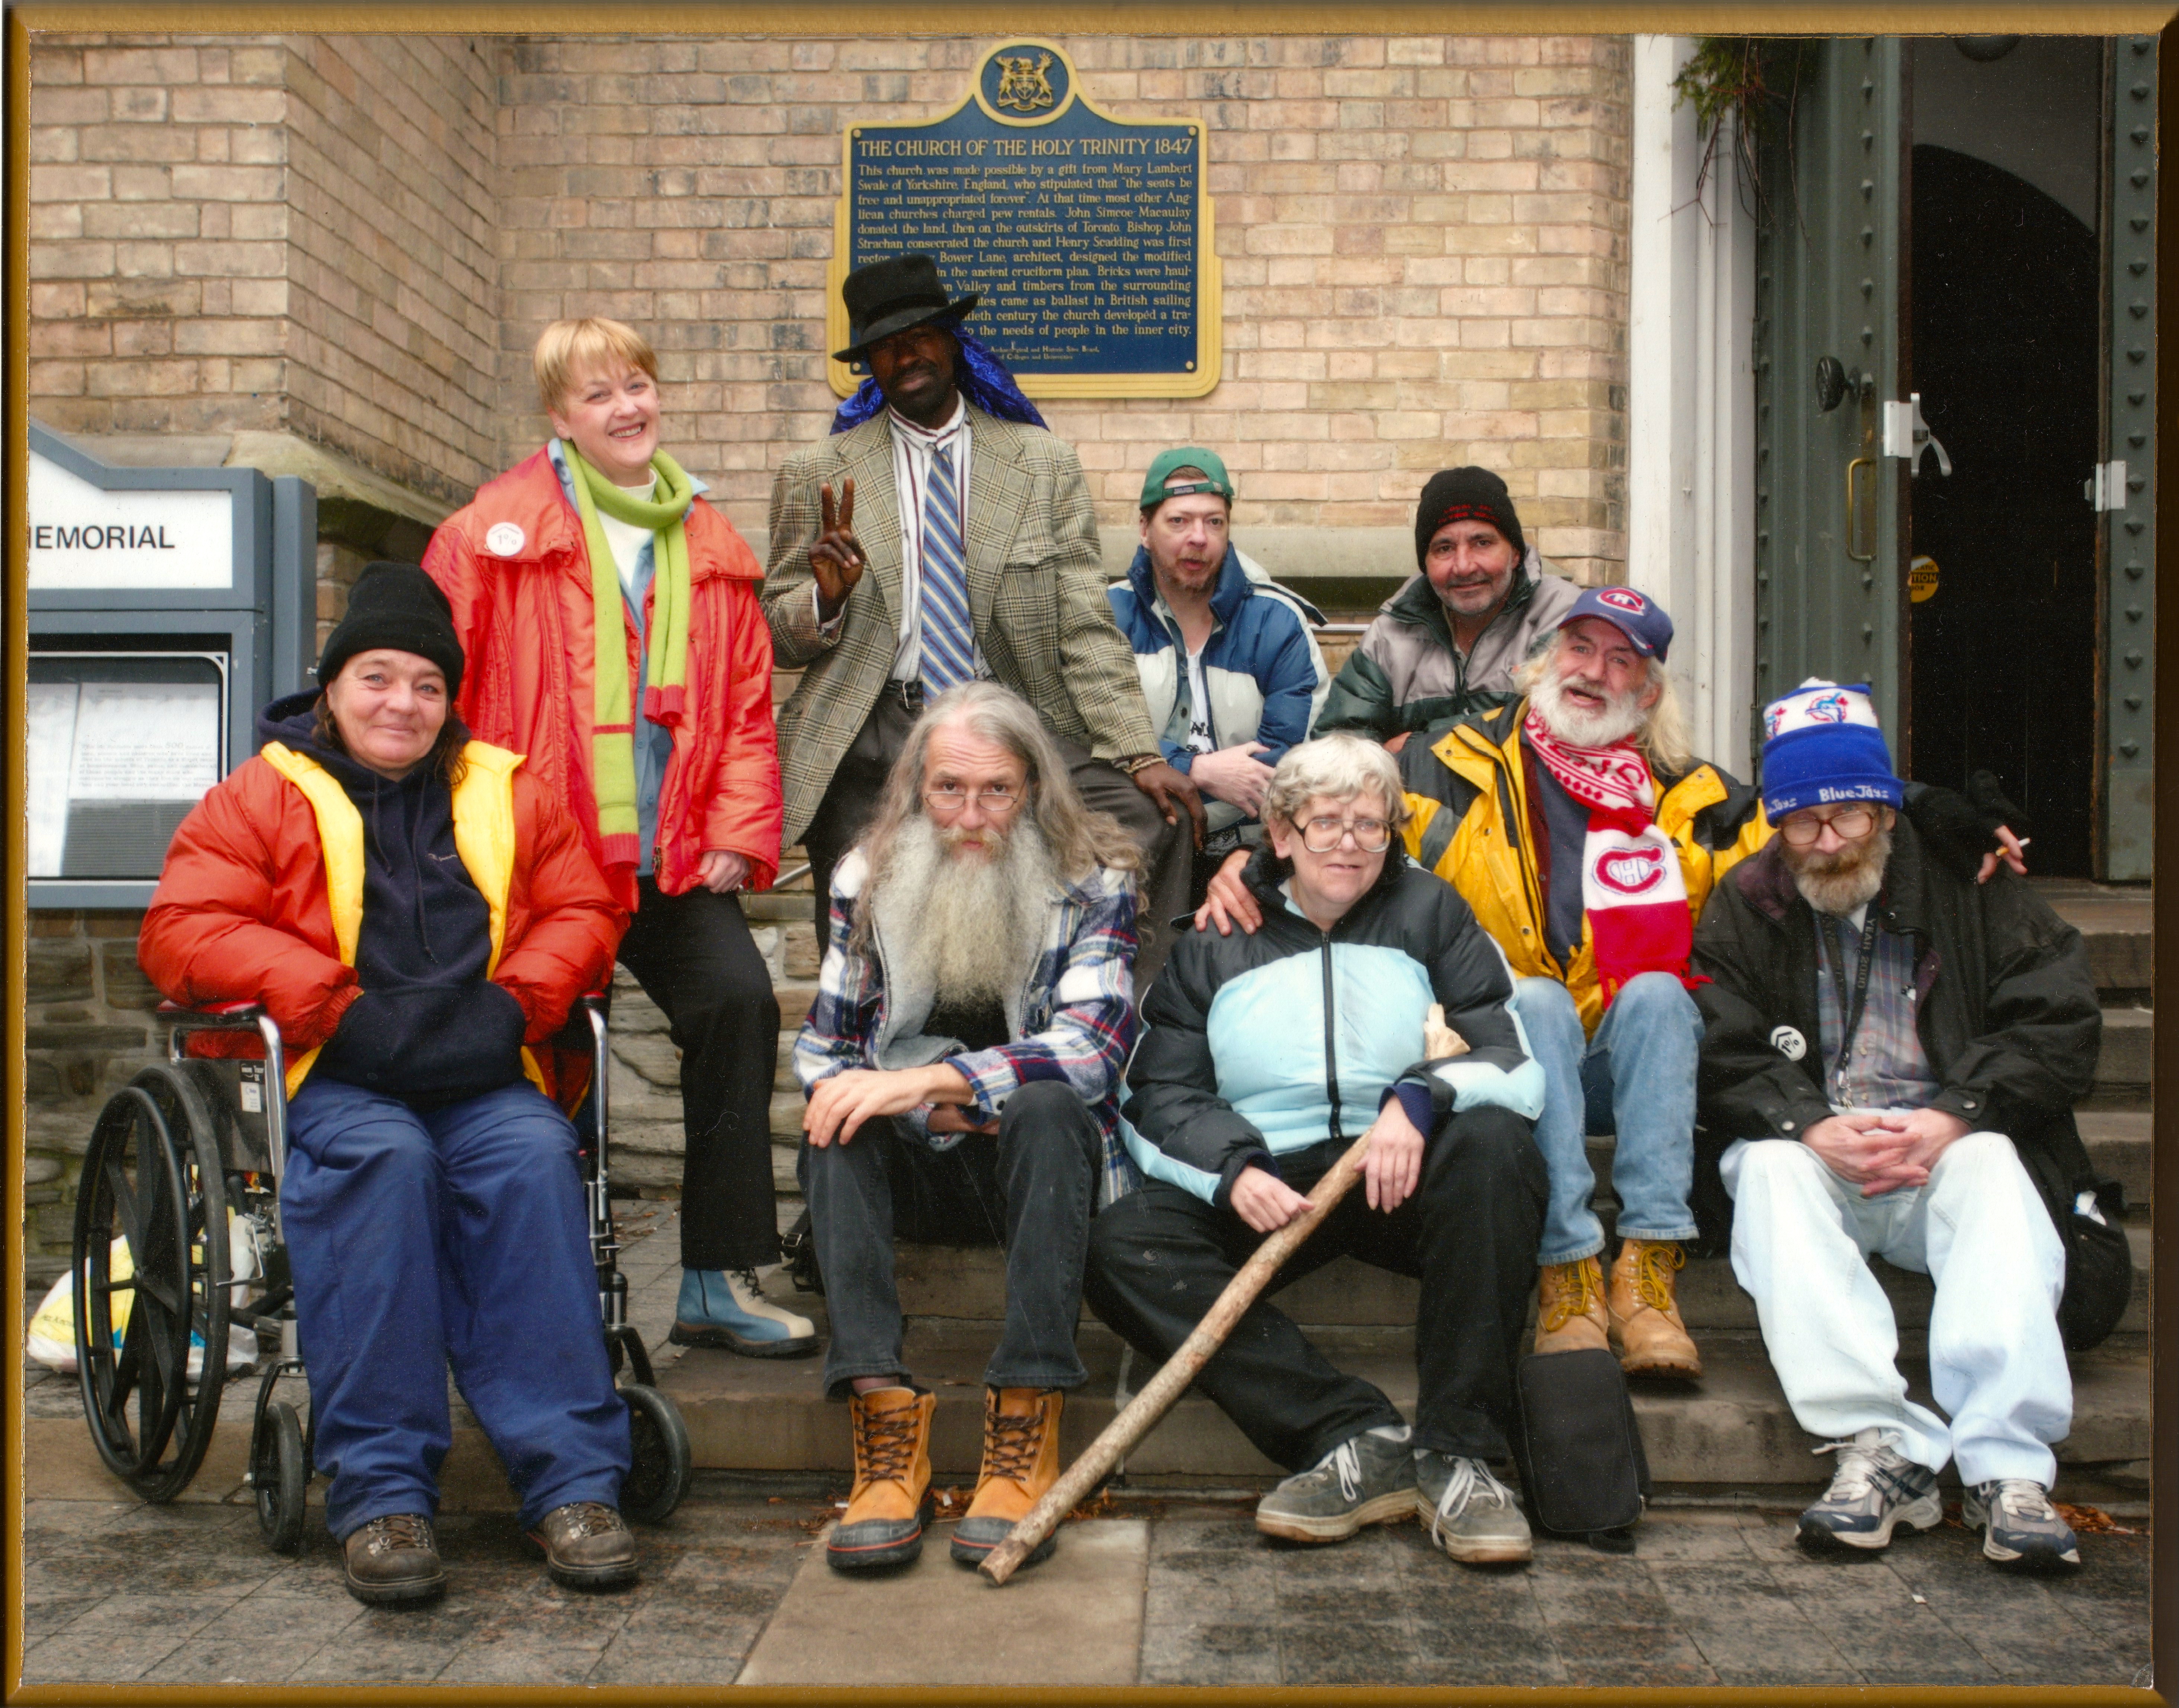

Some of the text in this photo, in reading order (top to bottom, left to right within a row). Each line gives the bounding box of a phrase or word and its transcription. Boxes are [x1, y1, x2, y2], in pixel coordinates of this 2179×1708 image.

[858, 138, 1192, 156] THE CHURCH OF THE HOLY TRINITY 1847
[858, 164, 882, 176] This
[886, 165, 922, 175] church
[953, 164, 980, 175] made
[984, 164, 1026, 177] possible
[1031, 164, 1043, 177] by
[1058, 163, 1076, 176] gift
[1082, 164, 1106, 174] from
[1113, 163, 1142, 177] Mary
[1147, 161, 1191, 174] Lambert
[858, 179, 888, 190] Swale
[892, 180, 901, 190] of
[1014, 179, 1035, 189] who
[1040, 178, 1092, 192] stipulated
[1098, 177, 1117, 188] that
[1147, 179, 1175, 188] seats
[1180, 177, 1192, 188] be
[858, 194, 879, 205] free
[884, 194, 902, 204] and
[907, 193, 985, 207] unappropriated
[1037, 193, 1048, 203] At
[1054, 193, 1073, 203] that
[1079, 193, 1101, 203] time
[1106, 193, 1130, 203] most
[1134, 192, 1162, 203] other
[1167, 191, 1191, 205] Ang-
[858, 209, 884, 220] lican
[889, 208, 937, 219] churches
[943, 208, 985, 220] charged
[991, 210, 1013, 221] pew
[1065, 207, 1090, 218] John
[1096, 206, 1133, 217] Simcoe
[1139, 206, 1191, 220] Macaulay
[858, 223, 897, 234] donated
[903, 223, 918, 234] the
[952, 223, 974, 233] then
[996, 222, 1012, 233] the
[1016, 222, 1063, 233] outskirts
[1068, 222, 1077, 232] of
[1127, 221, 1162, 235] Bishop
[1166, 221, 1191, 233] John
[858, 237, 902, 249] Strachan
[907, 237, 968, 249] consecrated
[974, 237, 989, 247] the
[993, 237, 1028, 247] church
[1032, 237, 1051, 247] and
[1056, 236, 1089, 250] Henry
[1093, 236, 1139, 249] Scadding
[1169, 236, 1191, 247] first
[940, 251, 973, 262] Bower
[1070, 251, 1116, 264] designed
[1122, 251, 1138, 261] the
[1144, 250, 1191, 262] modified
[936, 267, 946, 277] in
[951, 266, 967, 276] the
[971, 266, 1007, 277] ancient
[1012, 266, 1062, 276] cruciform
[1098, 265, 1130, 276] Bricks
[1135, 268, 1160, 276] were
[1165, 265, 1191, 276] haul-
[956, 280, 990, 294] Valley
[997, 280, 1016, 291] and
[1023, 280, 1063, 291] timbers
[1070, 280, 1094, 290] from
[1101, 280, 1116, 291] the
[1123, 279, 1191, 292] surrounding
[1001, 297, 1028, 306] came
[1051, 295, 1087, 306] ballast
[1094, 295, 1104, 306] in
[1111, 294, 1147, 305] British
[1153, 294, 1191, 308] sailing
[996, 311, 1037, 323] century
[1042, 310, 1058, 320] the
[1063, 309, 1099, 320] church
[1172, 310, 1191, 320] tra-
[980, 325, 996, 335] the
[1003, 325, 1033, 335] needs
[1039, 324, 1048, 335] of
[1054, 324, 1089, 338] people
[1095, 324, 1106, 335] in
[1112, 324, 1128, 335] the
[1135, 324, 1163, 335] inner
[1169, 324, 1191, 338] city.
[29, 525, 175, 550] EMORIAL
